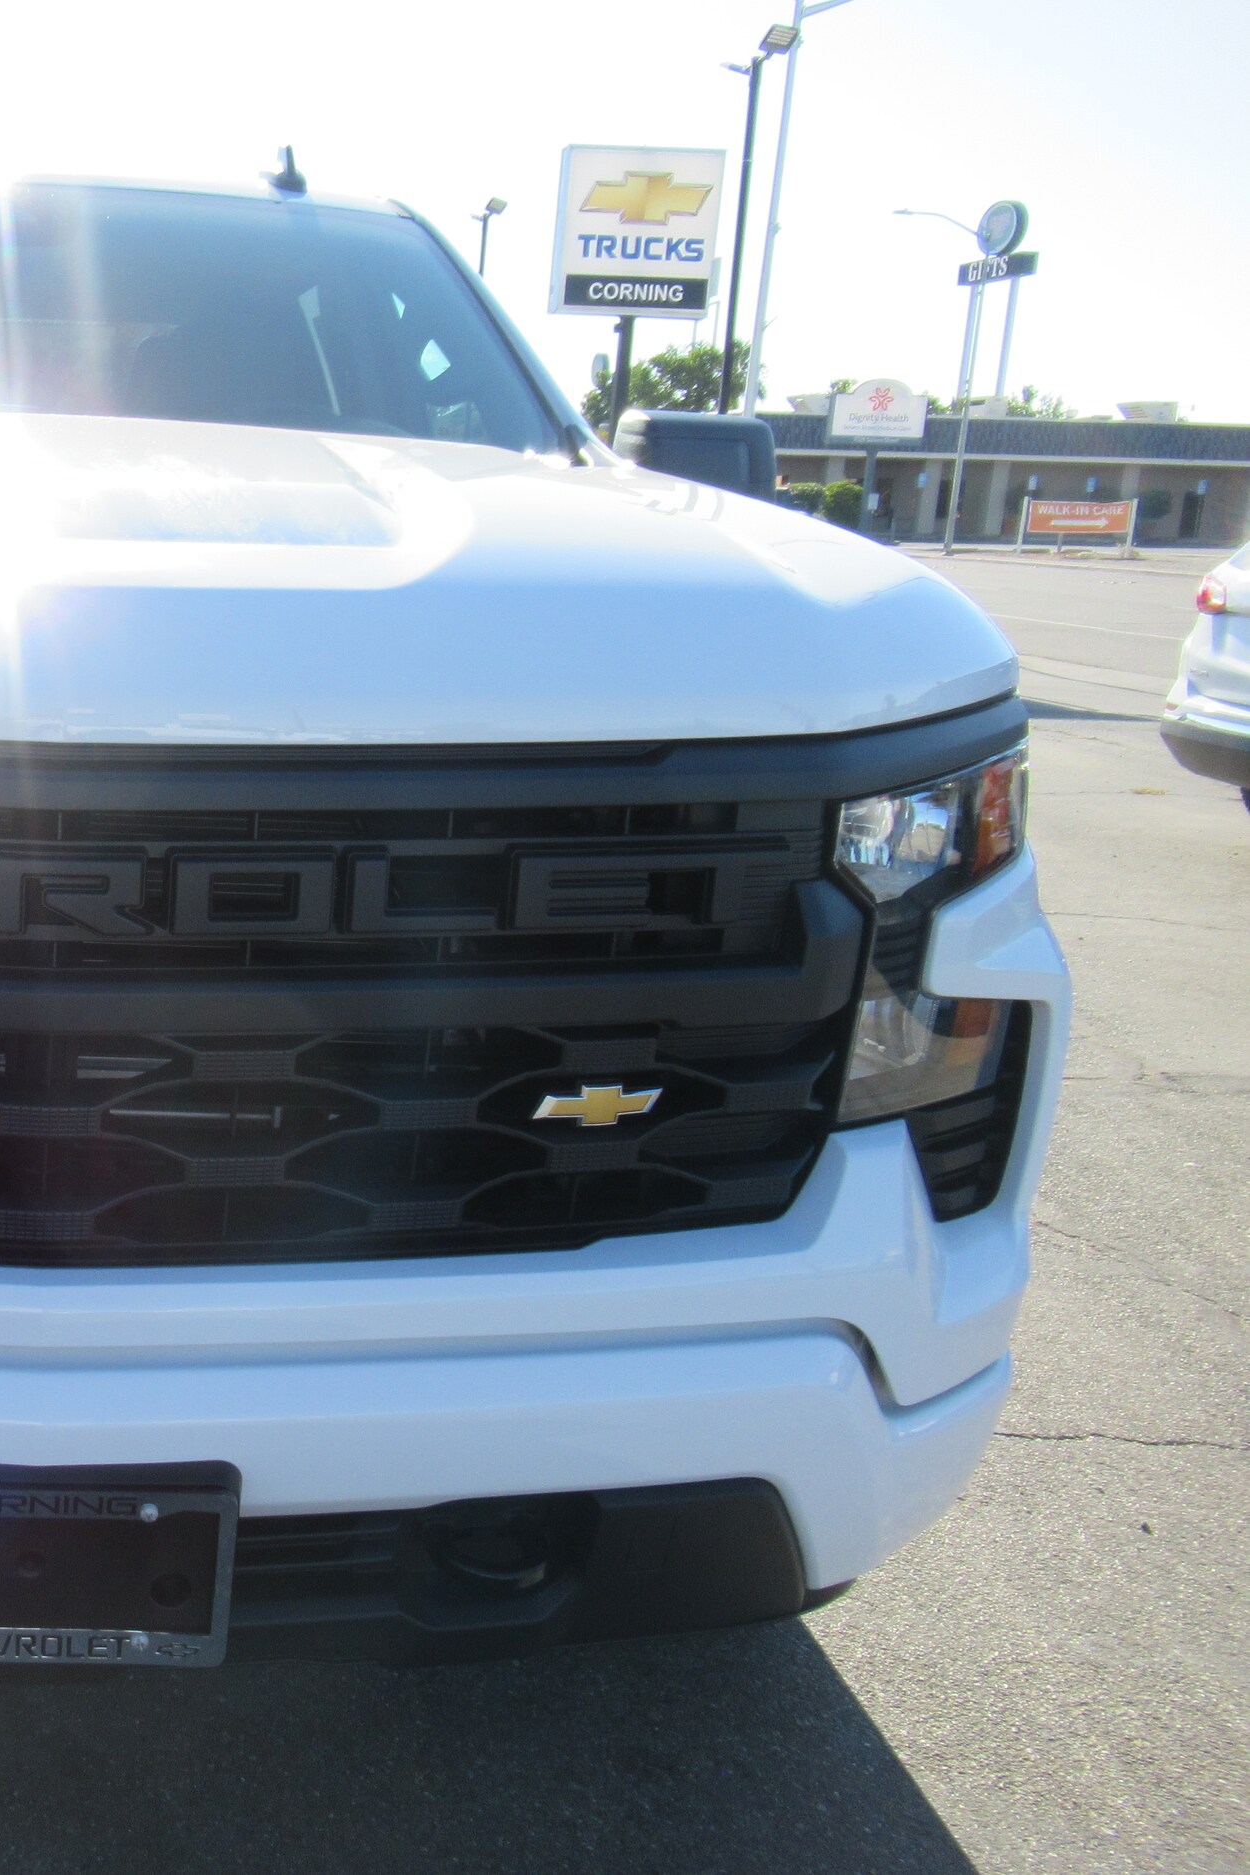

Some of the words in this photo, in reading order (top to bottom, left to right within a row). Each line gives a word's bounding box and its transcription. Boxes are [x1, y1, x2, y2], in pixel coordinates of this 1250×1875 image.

[578, 233, 705, 262] TRUCKS
[588, 281, 684, 302] CORNING
[849, 413, 880, 424] Dignity
[880, 414, 909, 422] Health
[1037, 504, 1089, 516] WALK-IN
[1093, 504, 1125, 515] CARE
